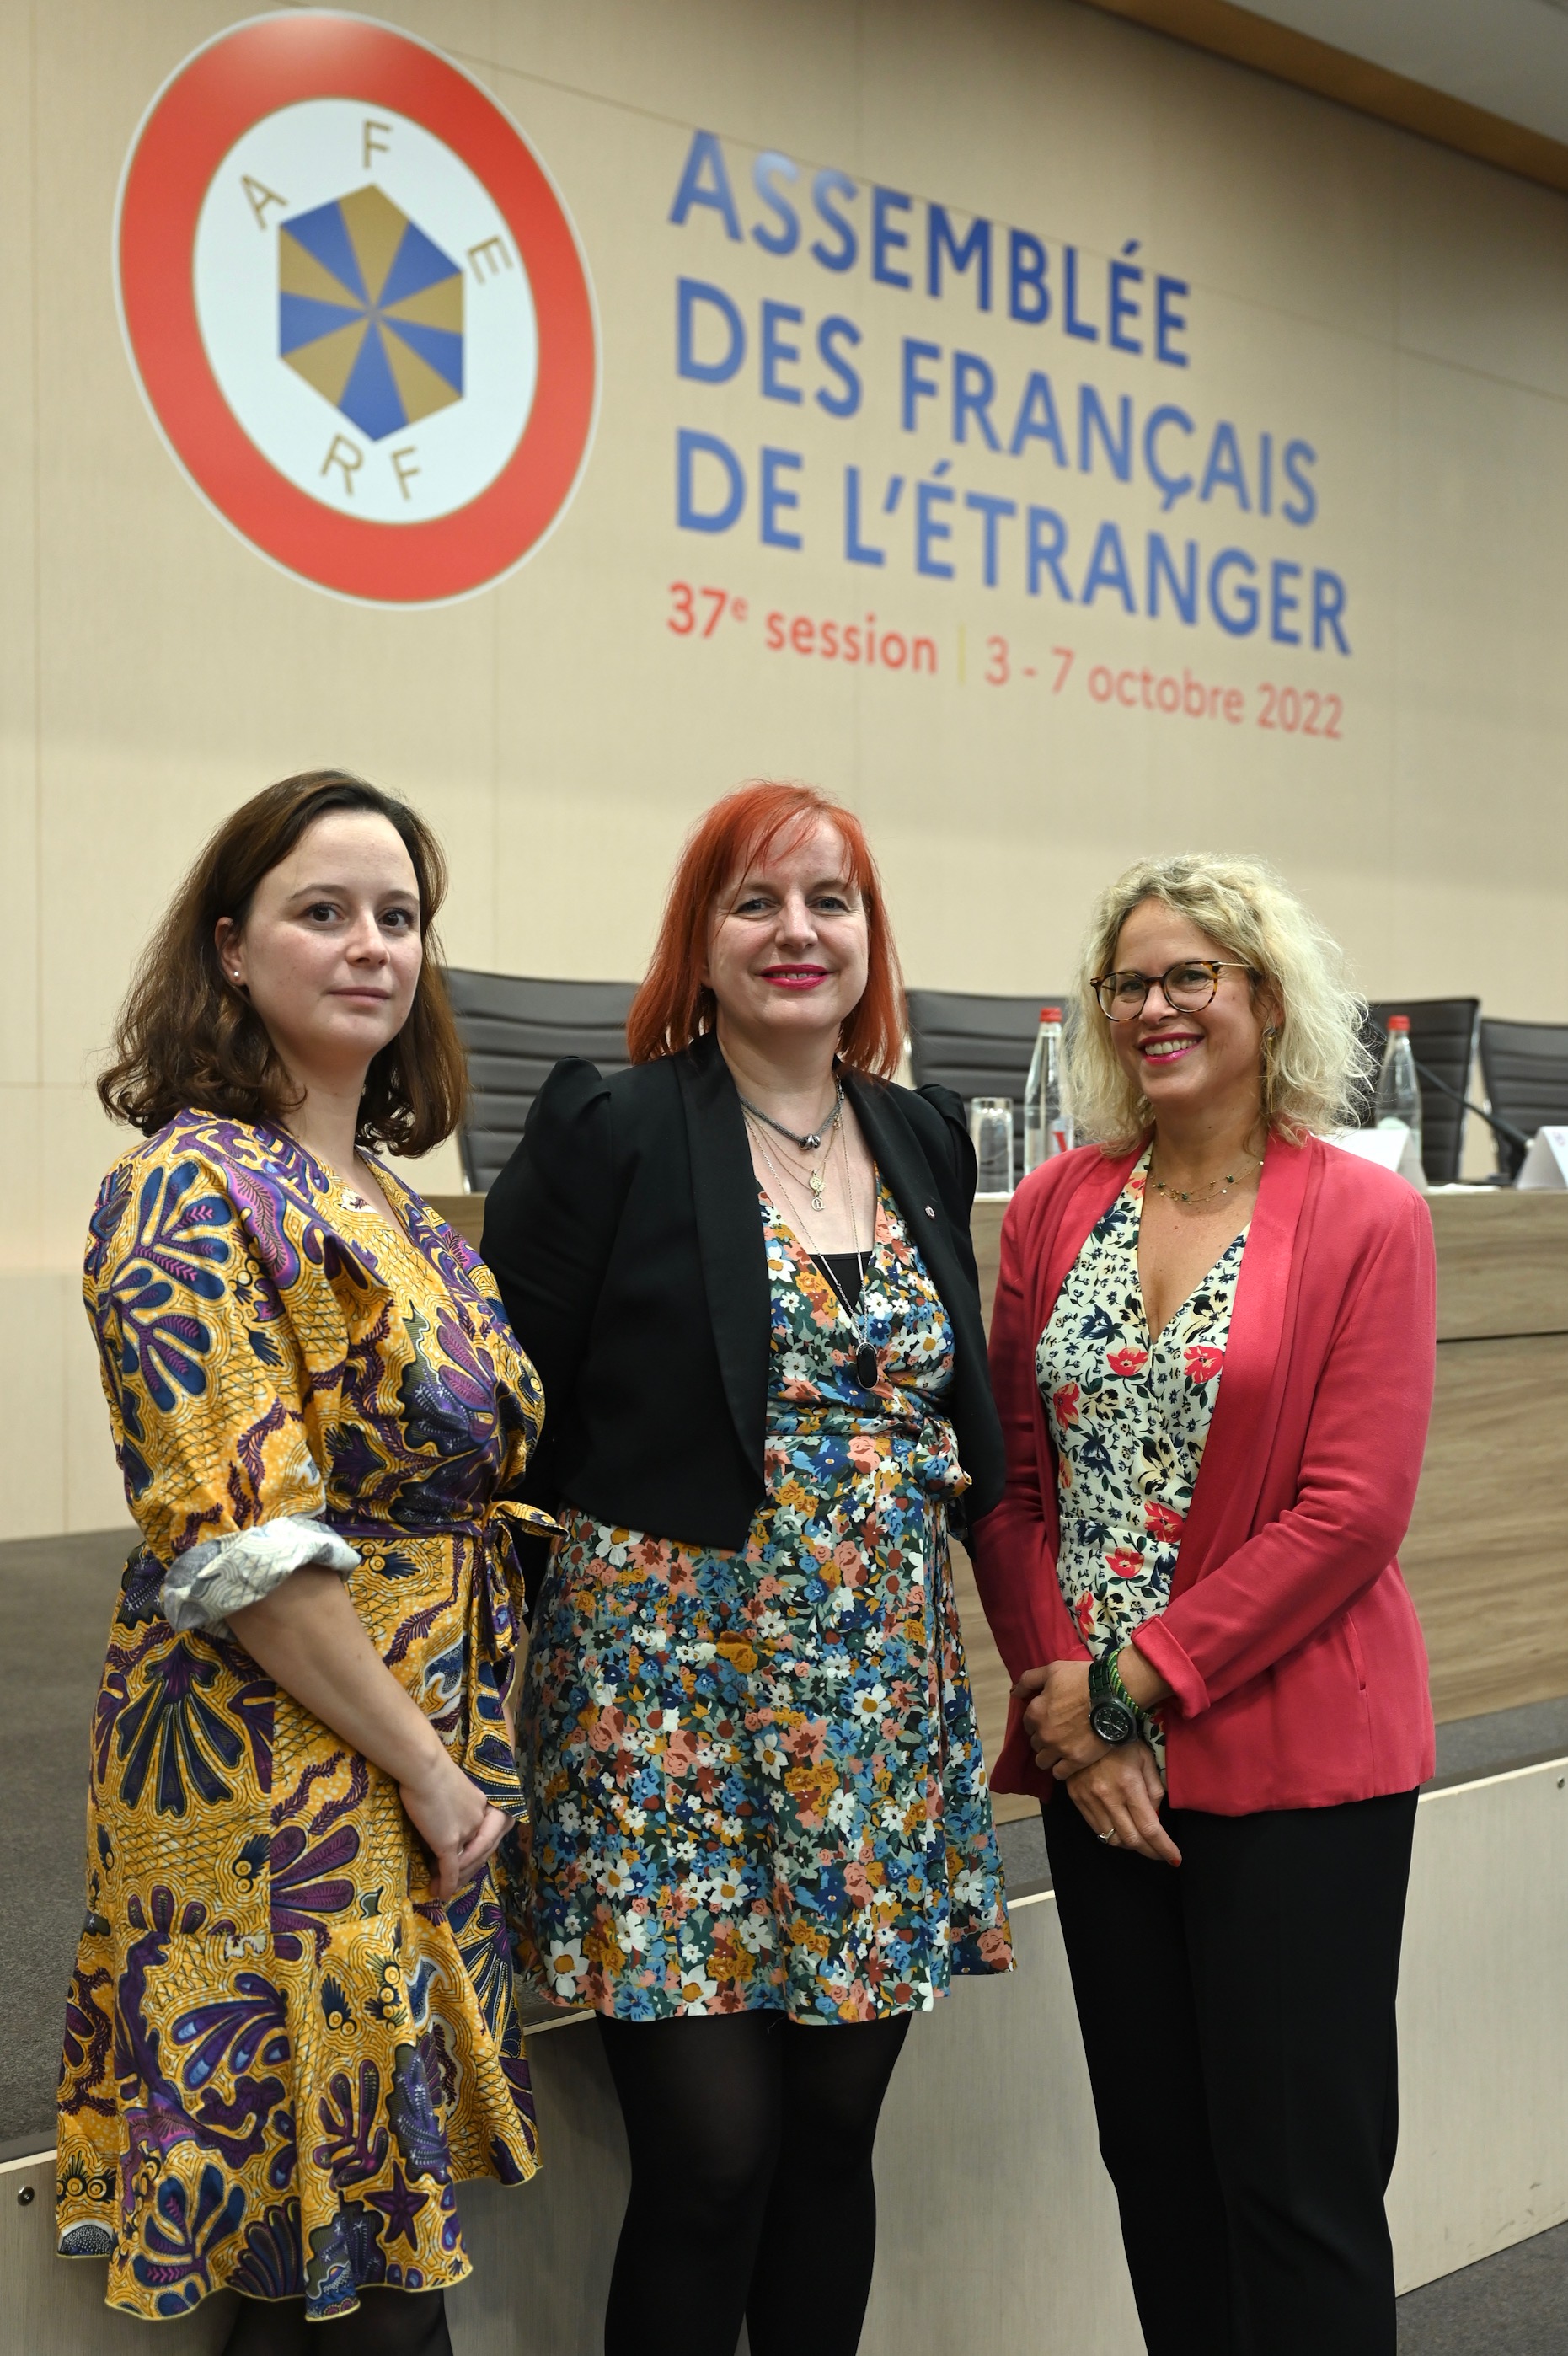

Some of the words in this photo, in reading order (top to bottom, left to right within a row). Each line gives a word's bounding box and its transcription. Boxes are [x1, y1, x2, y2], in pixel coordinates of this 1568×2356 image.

[668, 129, 1191, 369] ASSEMBLÉE
[677, 276, 863, 419] DES
[901, 336, 1319, 527] FRANÇAIS
[677, 426, 804, 552] DE
[764, 610, 939, 675] session
[985, 634, 1010, 687] 3
[1052, 645, 1075, 694] 7
[1087, 664, 1244, 726] octobre
[1256, 682, 1344, 741] 2022
